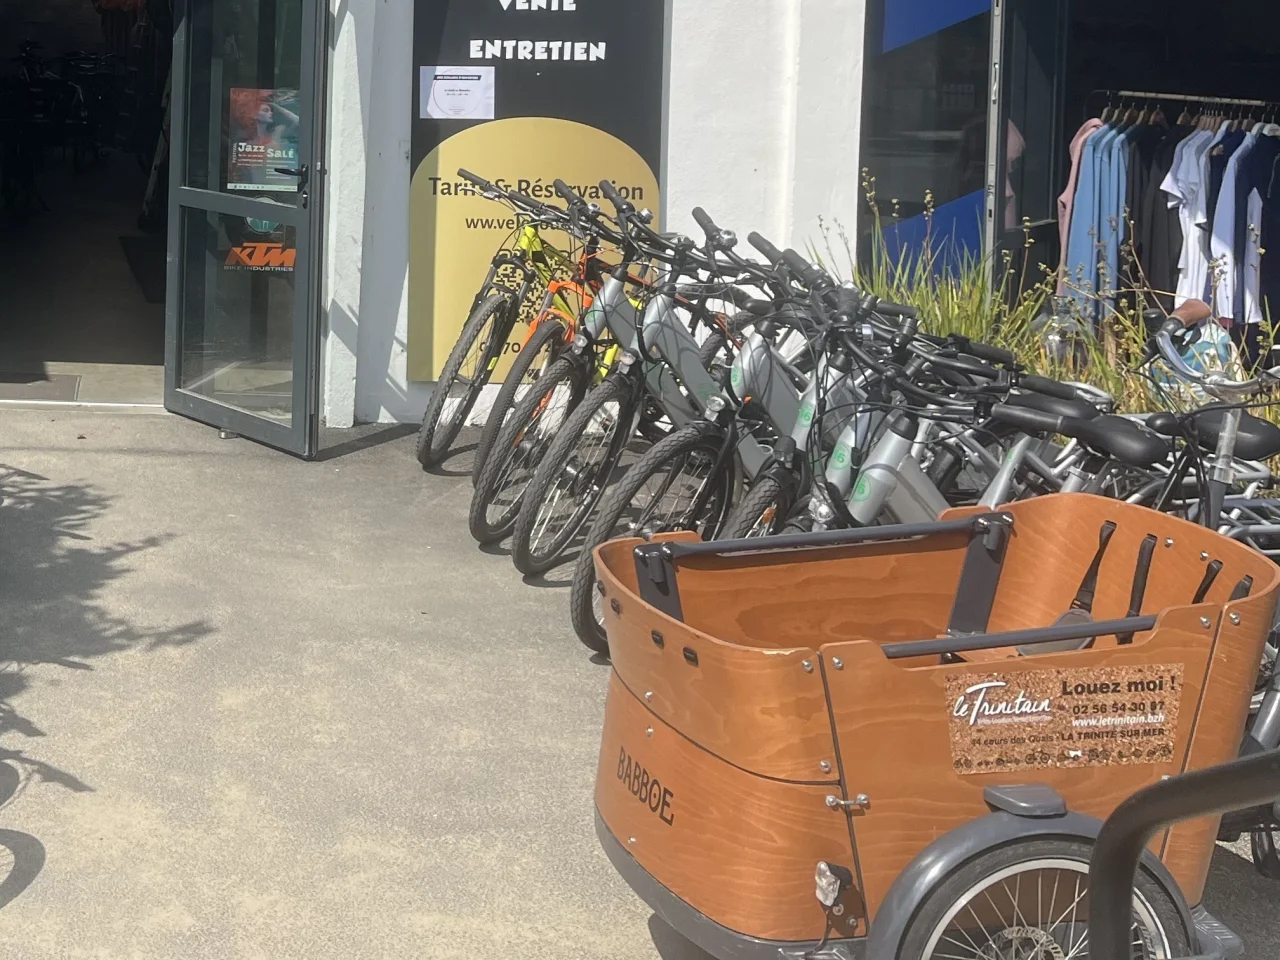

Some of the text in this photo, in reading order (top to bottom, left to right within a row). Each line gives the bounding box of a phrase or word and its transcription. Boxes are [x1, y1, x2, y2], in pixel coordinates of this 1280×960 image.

[470, 40, 606, 61] ENTRETIEN
[238, 142, 265, 152] Jazz
[225, 242, 297, 267] KTM
[1062, 675, 1176, 696] Louez moi !
[953, 681, 1052, 726] le Trinitain
[1072, 705, 1089, 715] 02
[1092, 704, 1108, 714] 56
[984, 737, 1008, 745] cours
[1011, 735, 1025, 744] des
[1028, 734, 1053, 743] Quais
[1061, 732, 1074, 741] LA
[1120, 729, 1141, 738] SUR
[1142, 727, 1165, 737] MER
[616, 745, 675, 827] BABBOE
